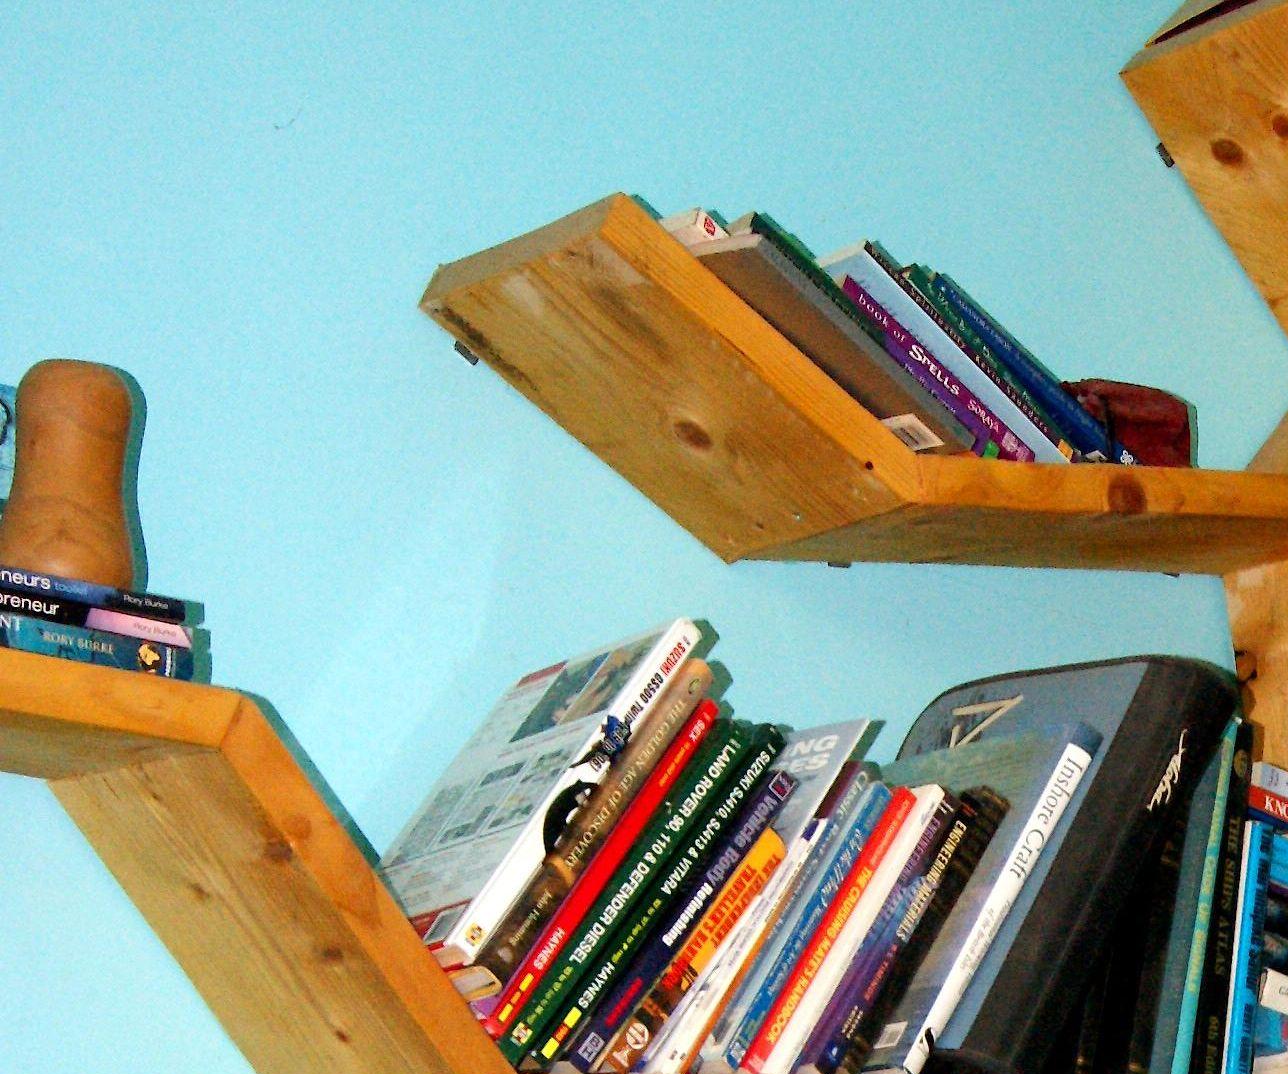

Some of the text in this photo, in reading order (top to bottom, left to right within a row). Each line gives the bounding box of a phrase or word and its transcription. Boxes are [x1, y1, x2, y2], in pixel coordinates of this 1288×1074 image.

[854, 292, 891, 328] book
[905, 342, 963, 397] SPELLS
[658, 642, 688, 676] SUZUKI
[633, 719, 673, 769] GOLDEN
[706, 743, 736, 778] LAND
[604, 790, 623, 810] OF
[617, 768, 638, 791] AGE
[677, 773, 713, 818] ROVER
[562, 806, 611, 868] DISCOVERY
[649, 830, 672, 855] 110
[659, 749, 771, 895] SUZUKI SJ410, SJ413 & VITARA
[663, 811, 686, 835] 90,
[1005, 755, 1086, 883] Inshore Craft
[1225, 817, 1241, 852] THE
[641, 850, 657, 865] &
[660, 792, 782, 949] Vehicle Body Refinishing
[897, 818, 968, 944] ENGINEERING MATERIALS
[597, 859, 650, 926] DEFENDER
[1219, 857, 1236, 909] SHIPS
[824, 884, 862, 939] CRUISING
[530, 926, 566, 969] HAYNES
[567, 920, 605, 966] DIESEL
[803, 936, 832, 977] MATE'S
[1212, 915, 1230, 975] ATLAS
[576, 961, 615, 1009] HAYNES
[763, 975, 809, 1045] HANDBOOK
